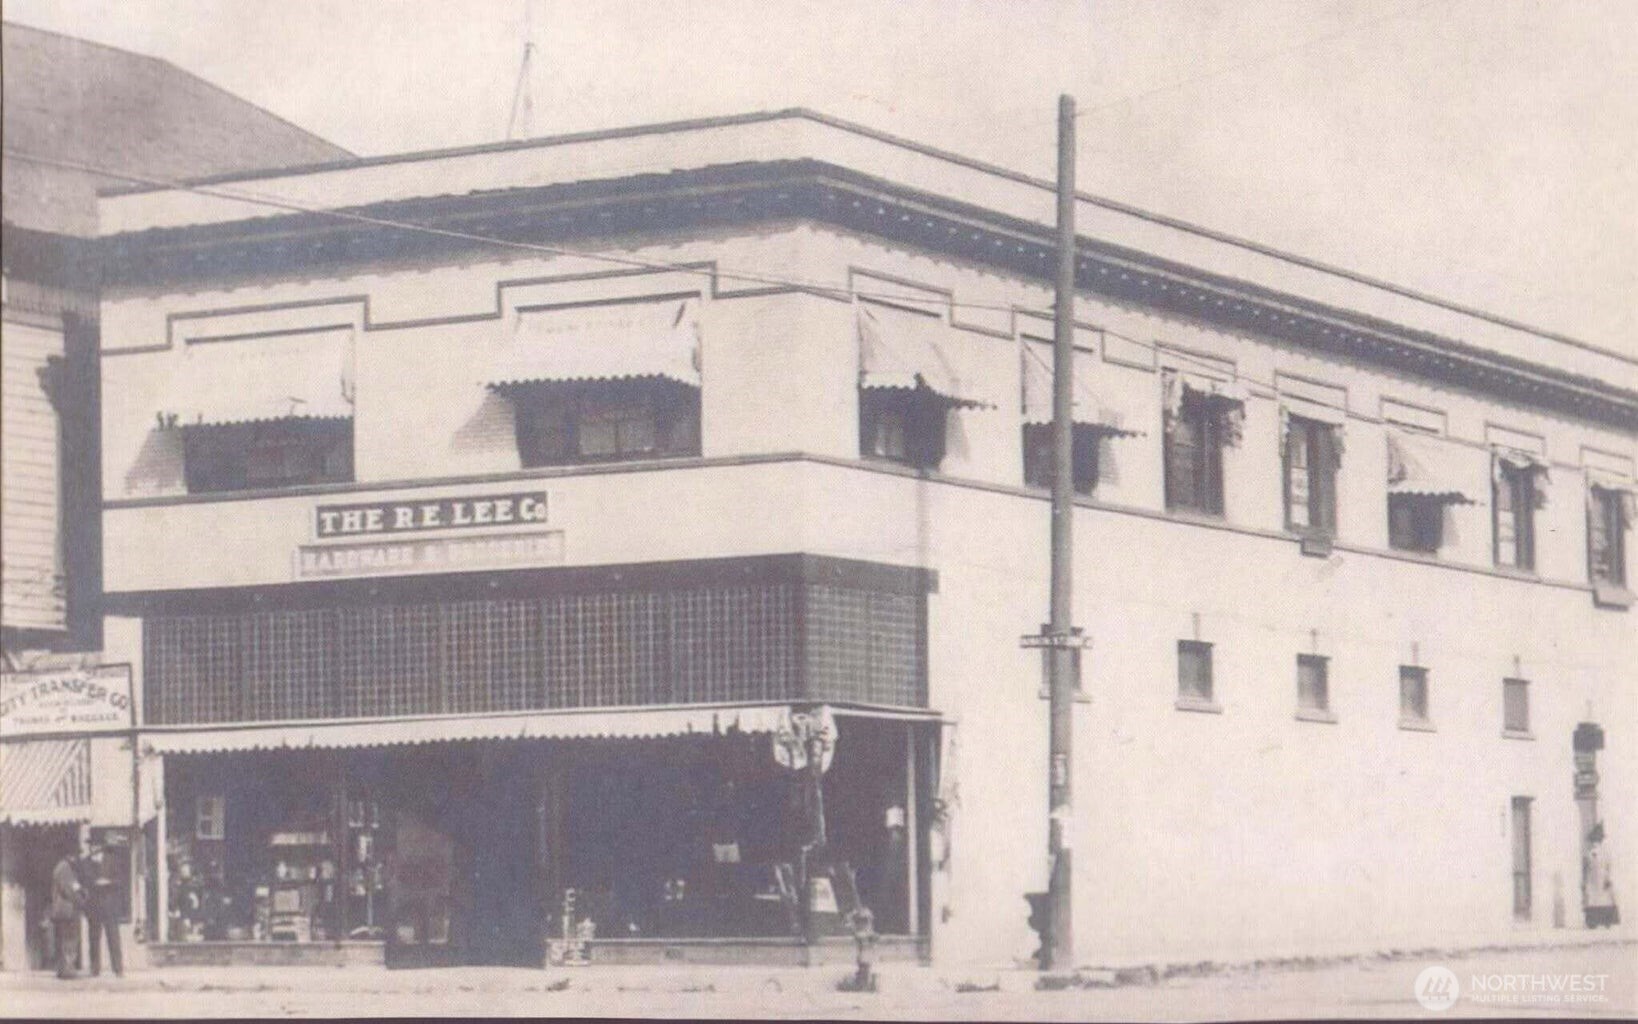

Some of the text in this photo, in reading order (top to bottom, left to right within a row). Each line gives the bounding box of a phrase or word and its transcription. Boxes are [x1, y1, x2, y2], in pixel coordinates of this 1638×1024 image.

[320, 509, 383, 532] THE
[394, 507, 414, 528] R
[422, 505, 442, 526] E
[452, 499, 514, 524] LEE
[31, 678, 107, 701] TRANSFER
